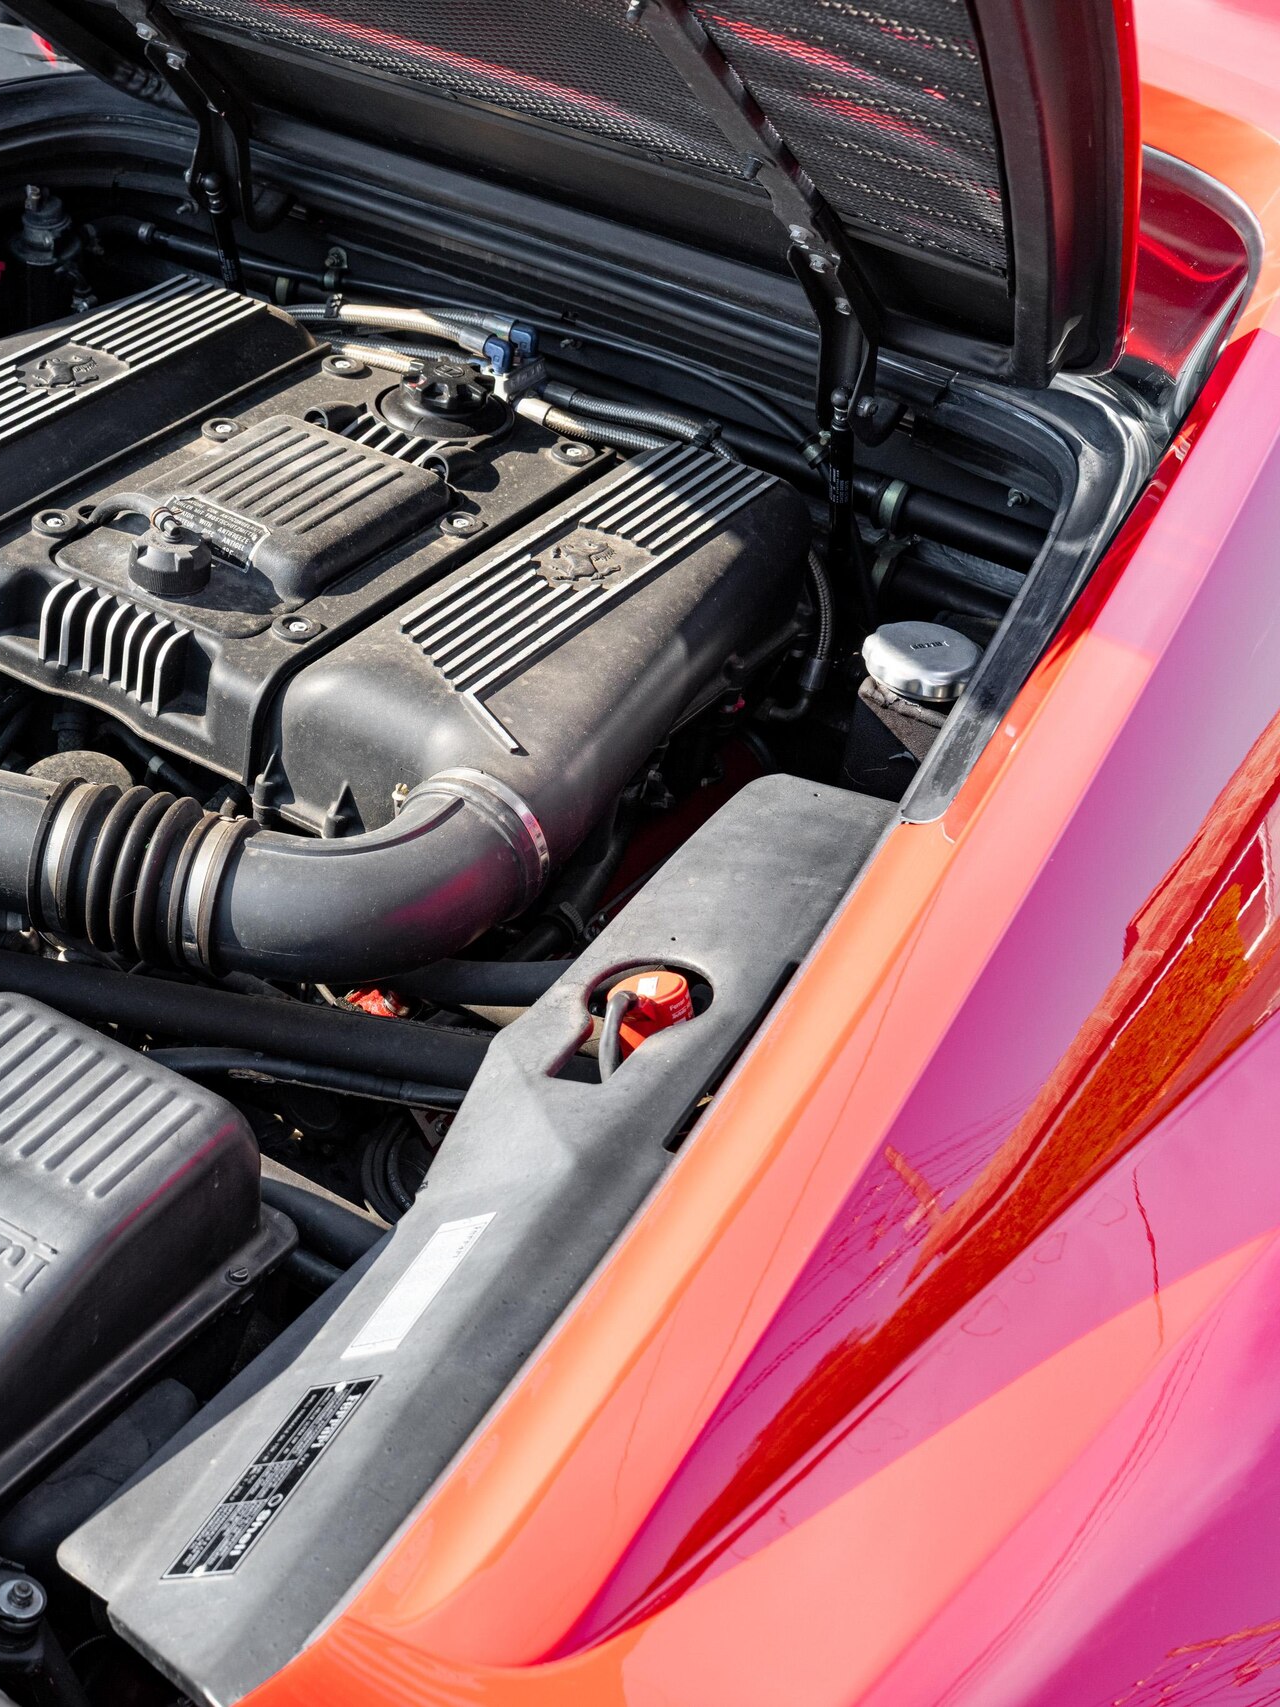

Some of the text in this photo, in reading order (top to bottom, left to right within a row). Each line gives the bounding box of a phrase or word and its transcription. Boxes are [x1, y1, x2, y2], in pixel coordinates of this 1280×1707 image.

[199, 518, 214, 528] WITH
[217, 526, 250, 545] ANTIFREEZE
[222, 536, 245, 552] ANTIGEL
[311, 1393, 362, 1449] Ferrari
[229, 1508, 272, 1556] Shell
